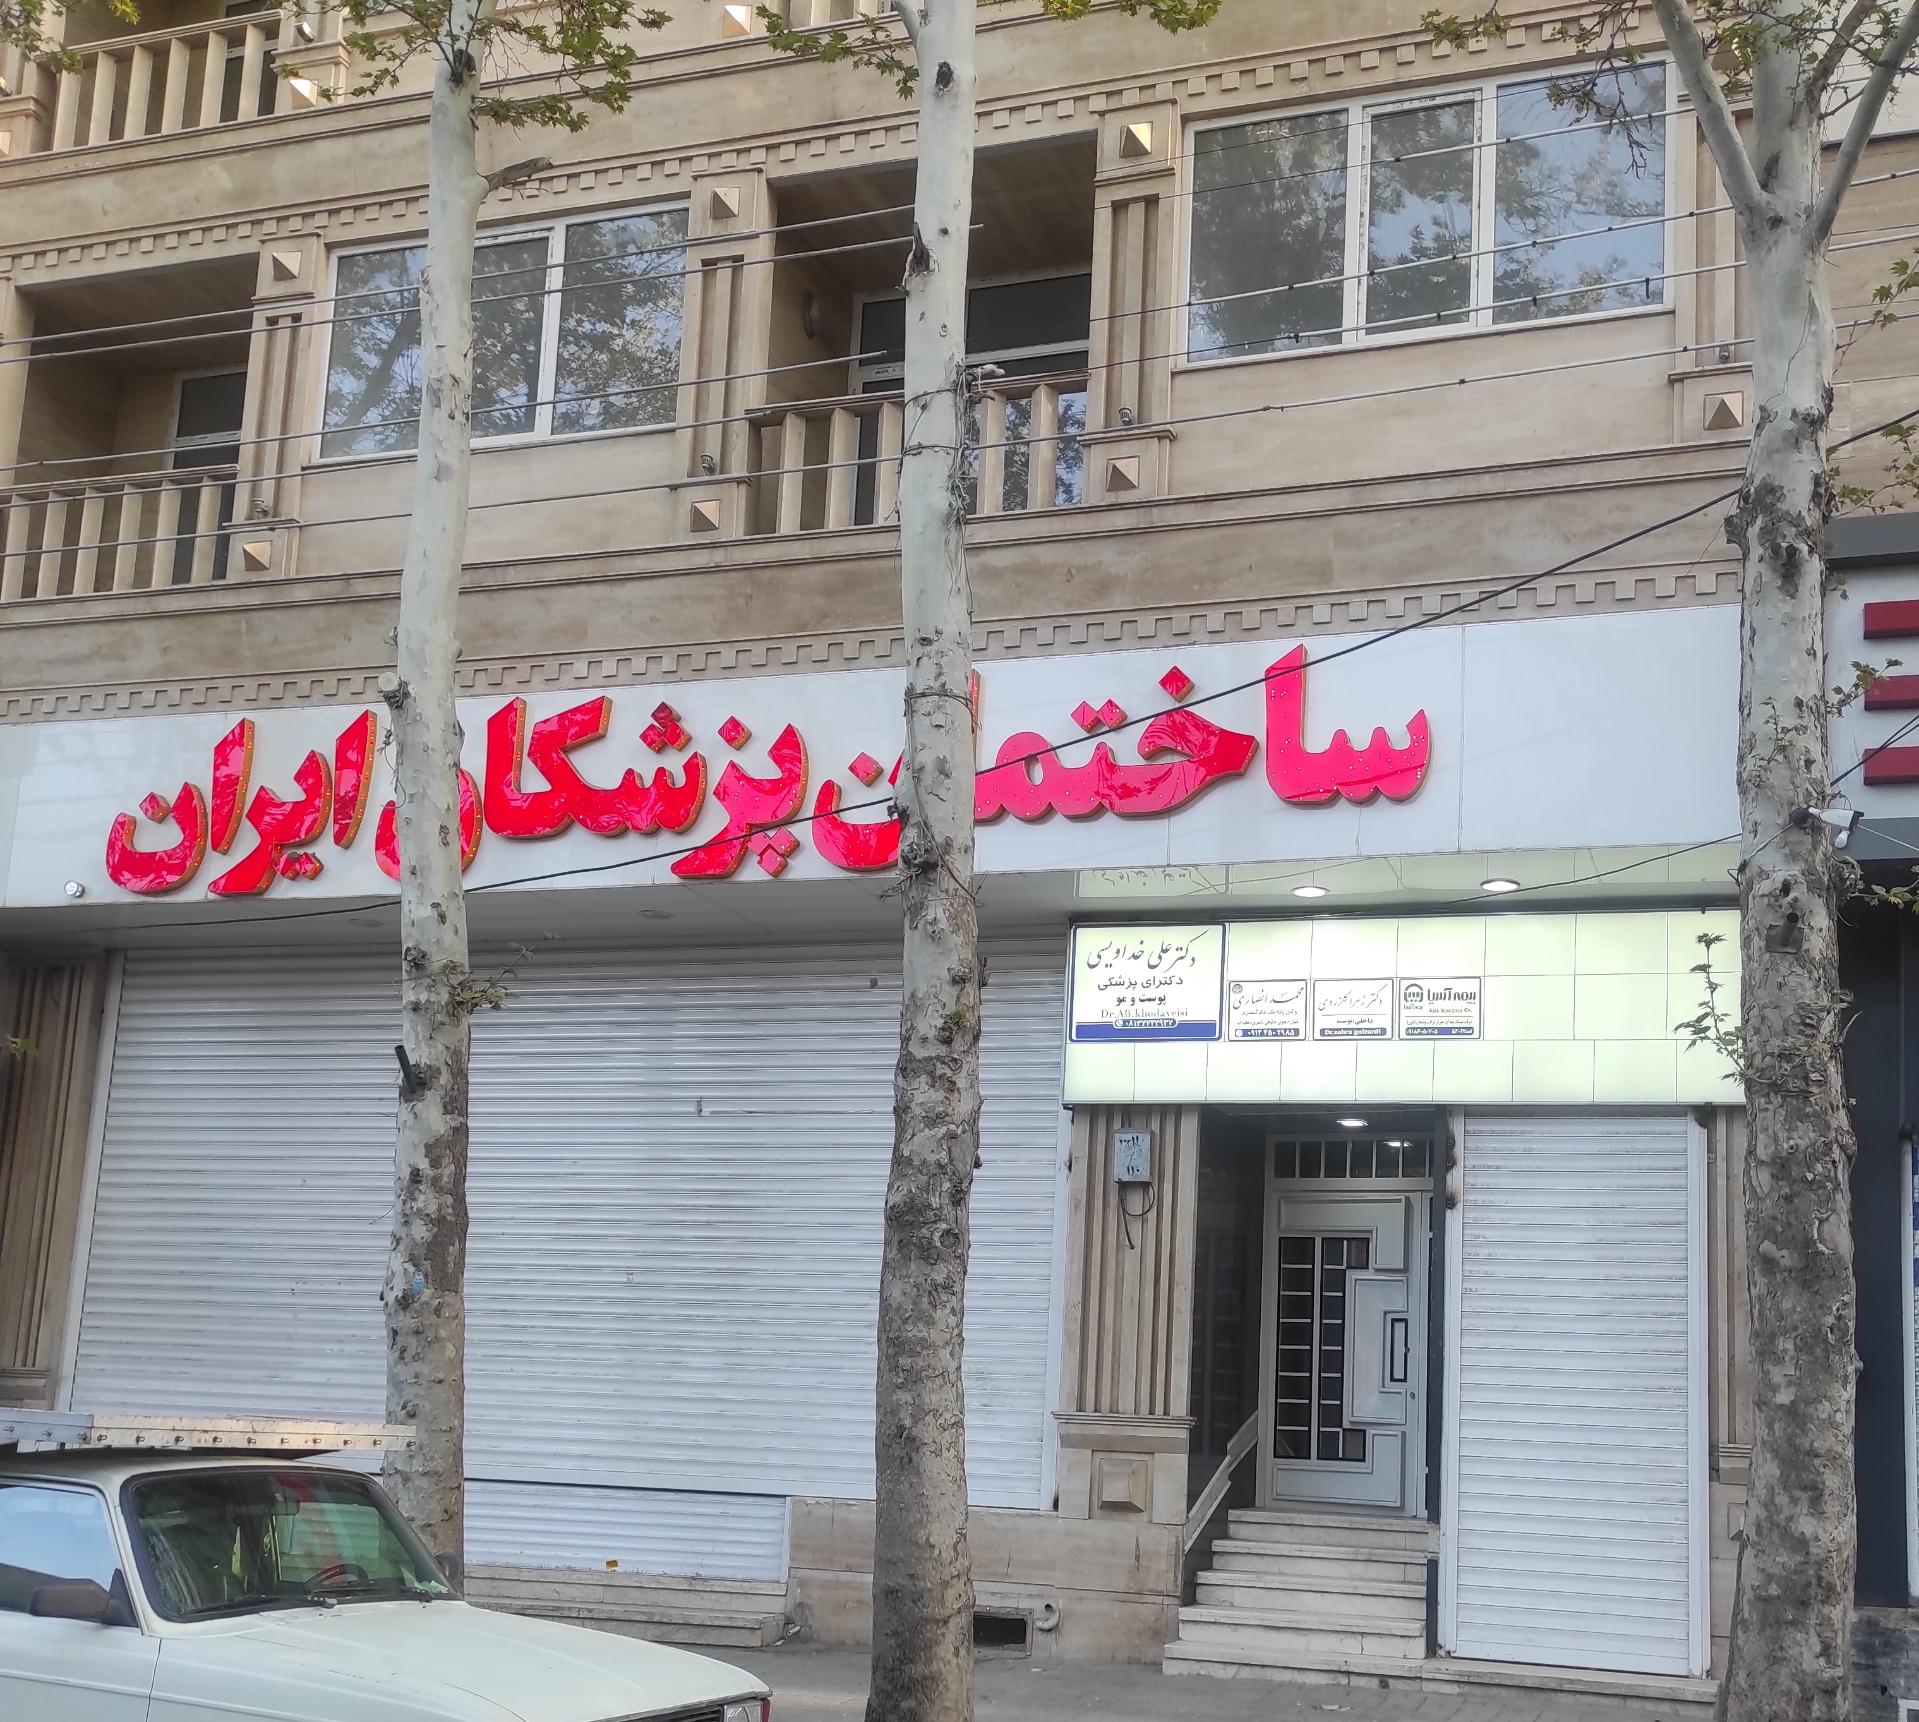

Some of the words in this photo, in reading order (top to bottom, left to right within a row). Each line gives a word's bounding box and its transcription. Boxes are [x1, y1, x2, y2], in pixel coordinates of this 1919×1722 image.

[812, 643, 1432, 872] ساختمن
[106, 709, 377, 896] ایران
[1147, 939, 1172, 969] علی
[1163, 928, 1208, 972] دکتر
[1098, 974, 1137, 991] پزشکی
[1141, 975, 1183, 988] دکترای
[1130, 997, 1136, 1006] و
[1138, 994, 1166, 1006] پوست
[1427, 987, 1453, 1005] آسیا
[1453, 991, 1476, 1005] بیمه
